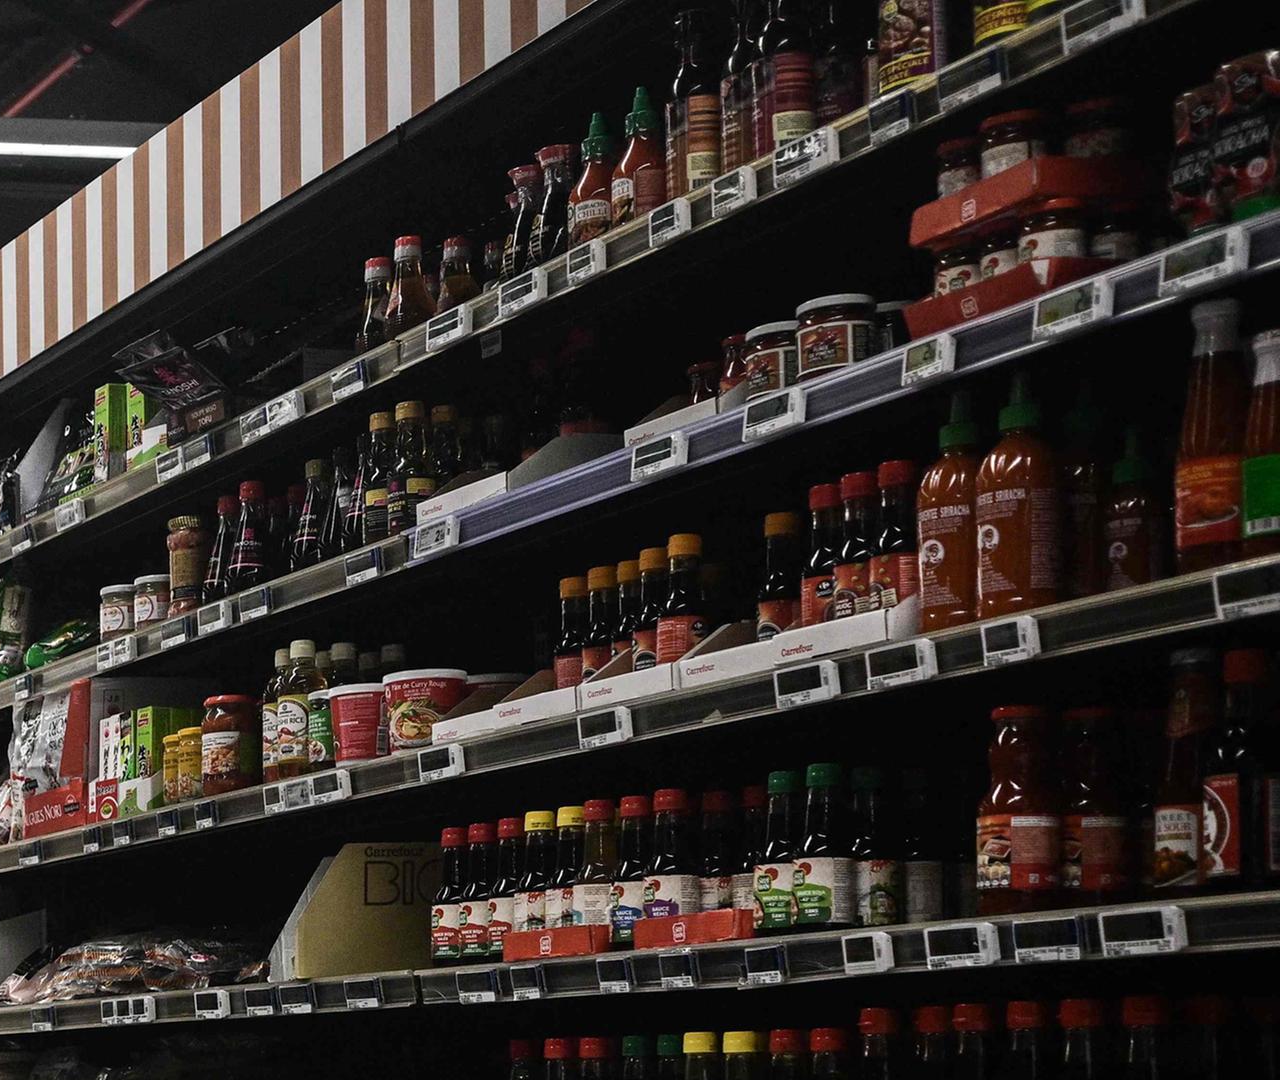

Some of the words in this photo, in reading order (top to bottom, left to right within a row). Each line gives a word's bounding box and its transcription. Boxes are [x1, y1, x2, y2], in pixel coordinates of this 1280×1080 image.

[577, 208, 608, 218] CHILLI
[781, 643, 814, 658] Carrefour
[686, 664, 715, 677] Carrefour
[587, 687, 612, 699] Carrefour
[499, 705, 523, 719] Carrefour
